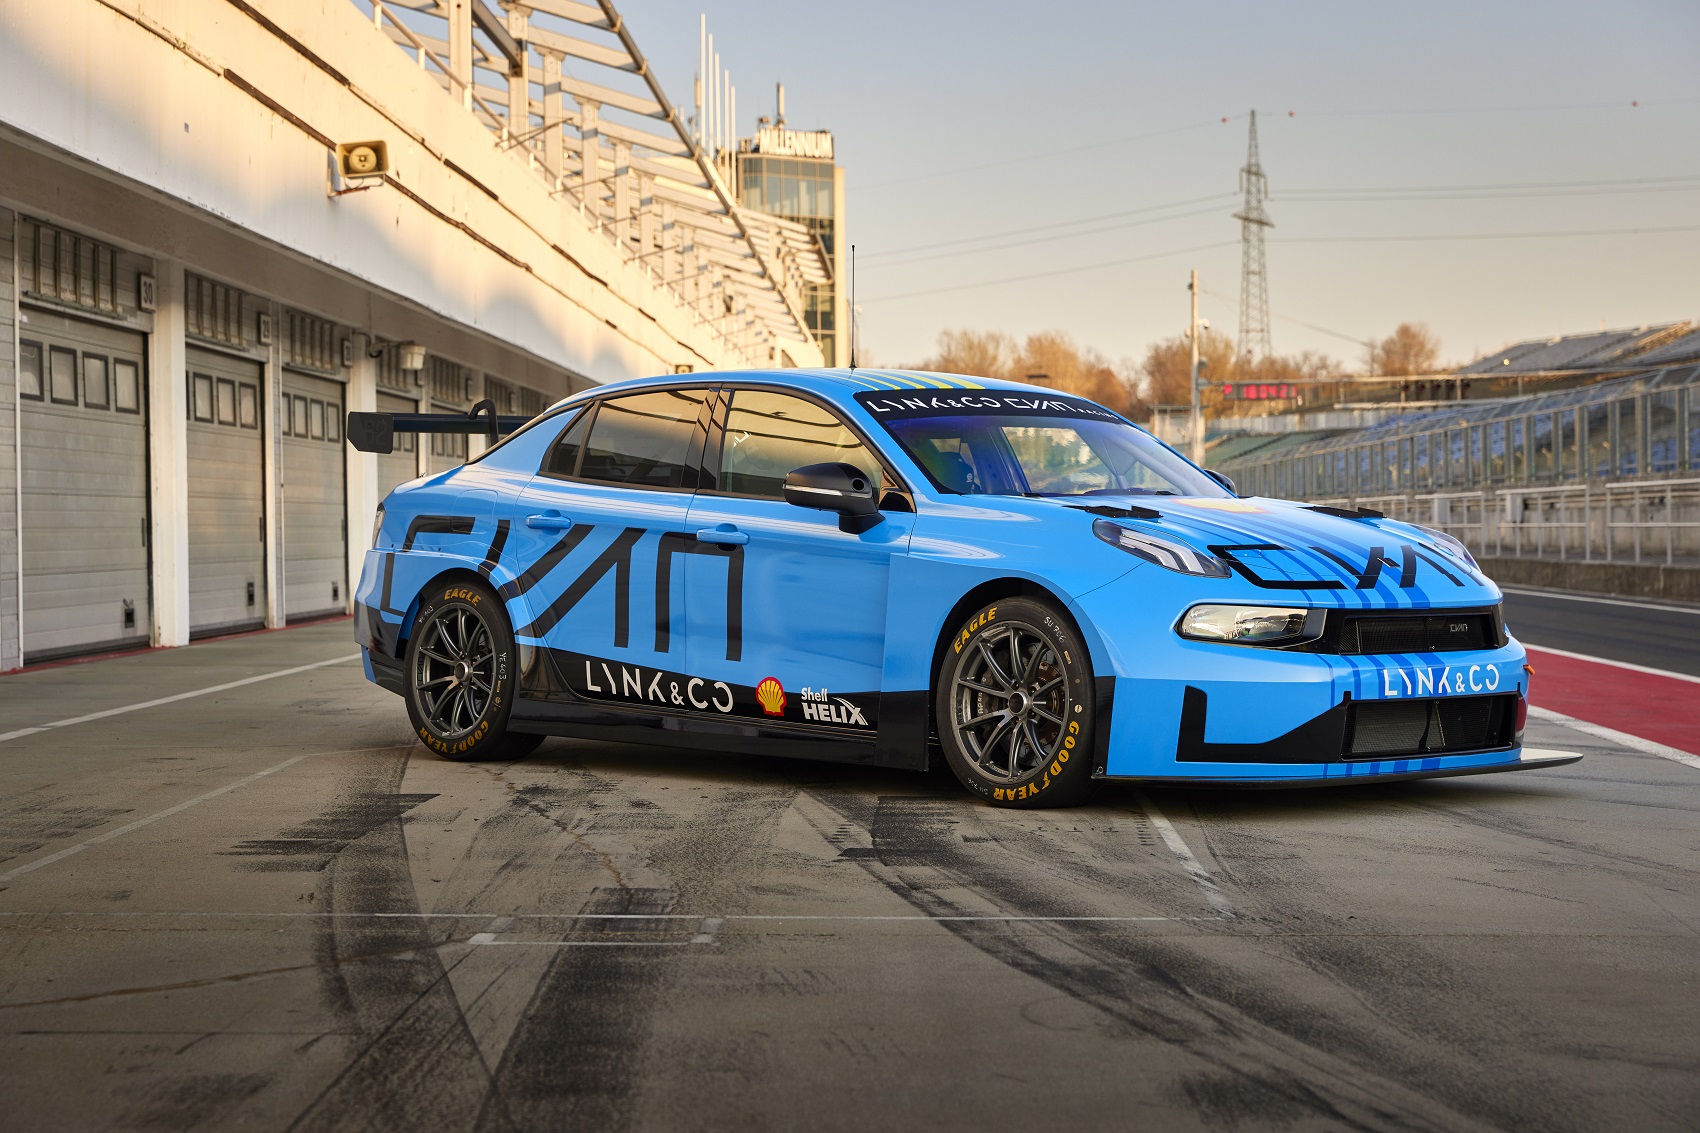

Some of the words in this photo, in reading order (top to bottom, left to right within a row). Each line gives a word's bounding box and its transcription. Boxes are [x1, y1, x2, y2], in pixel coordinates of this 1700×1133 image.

[760, 128, 833, 159] MILLENNIUM
[143, 281, 153, 305] 30
[444, 588, 481, 606] EAGLE
[953, 606, 998, 654] EAGLE
[800, 687, 828, 702] Shell
[801, 700, 869, 726] HELIX
